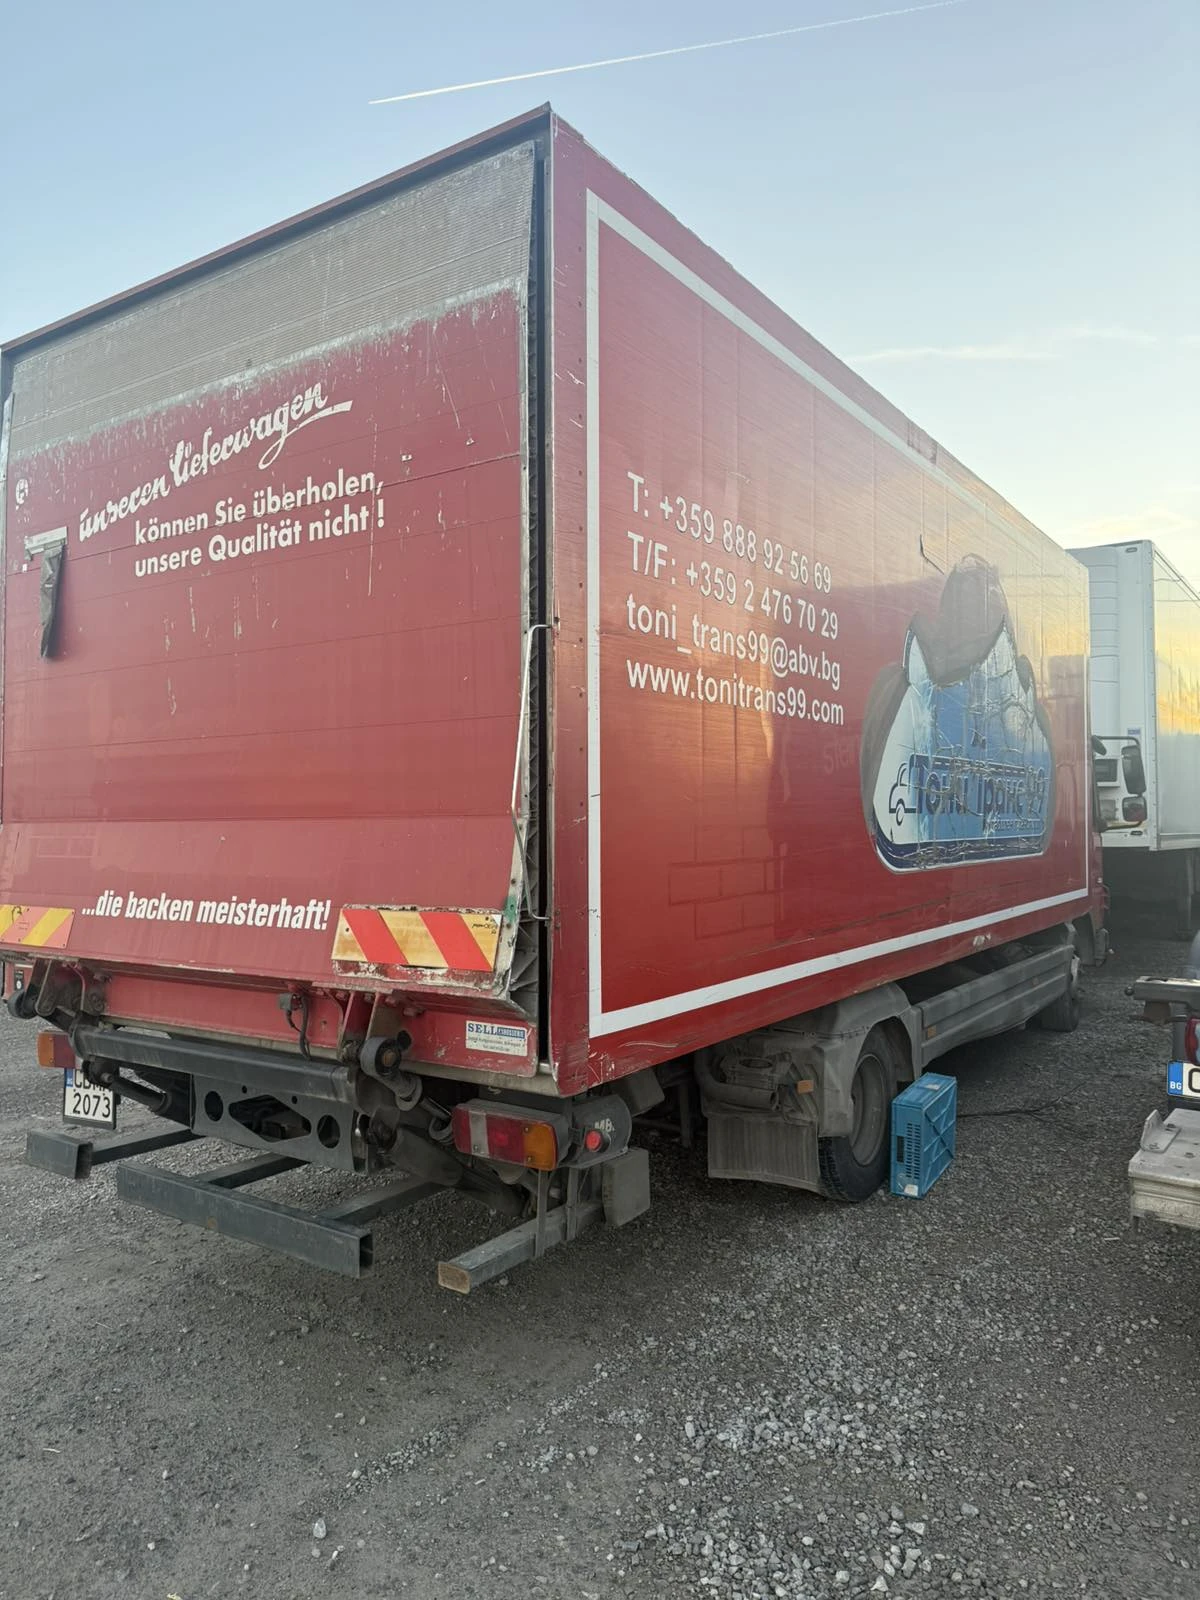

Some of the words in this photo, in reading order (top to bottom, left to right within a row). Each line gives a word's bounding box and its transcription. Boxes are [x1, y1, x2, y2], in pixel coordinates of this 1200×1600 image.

[135, 509, 209, 546] können
[214, 499, 247, 527] Sie
[252, 468, 384, 517] überholen,
[627, 472, 649, 517] T:
[660, 495, 715, 544] +359
[723, 519, 757, 562] 888
[763, 539, 784, 575] 92
[790, 550, 809, 585] 56
[814, 561, 832, 593] 69
[135, 545, 202, 577] unsere
[208, 519, 302, 563] Qualität
[686, 561, 737, 605] +359
[743, 579, 755, 612] 2
[761, 587, 792, 624] 476
[797, 599, 816, 632] 70
[821, 608, 838, 640] 29
[626, 593, 841, 691] toni_trans99@abv.bg
[626, 659, 845, 726] www.tonitrans99.com
[124, 891, 194, 922] backen
[196, 895, 332, 930] meisterhaft!
[72, 1092, 111, 1118] 2073
[1170, 1081, 1182, 1090] BG
